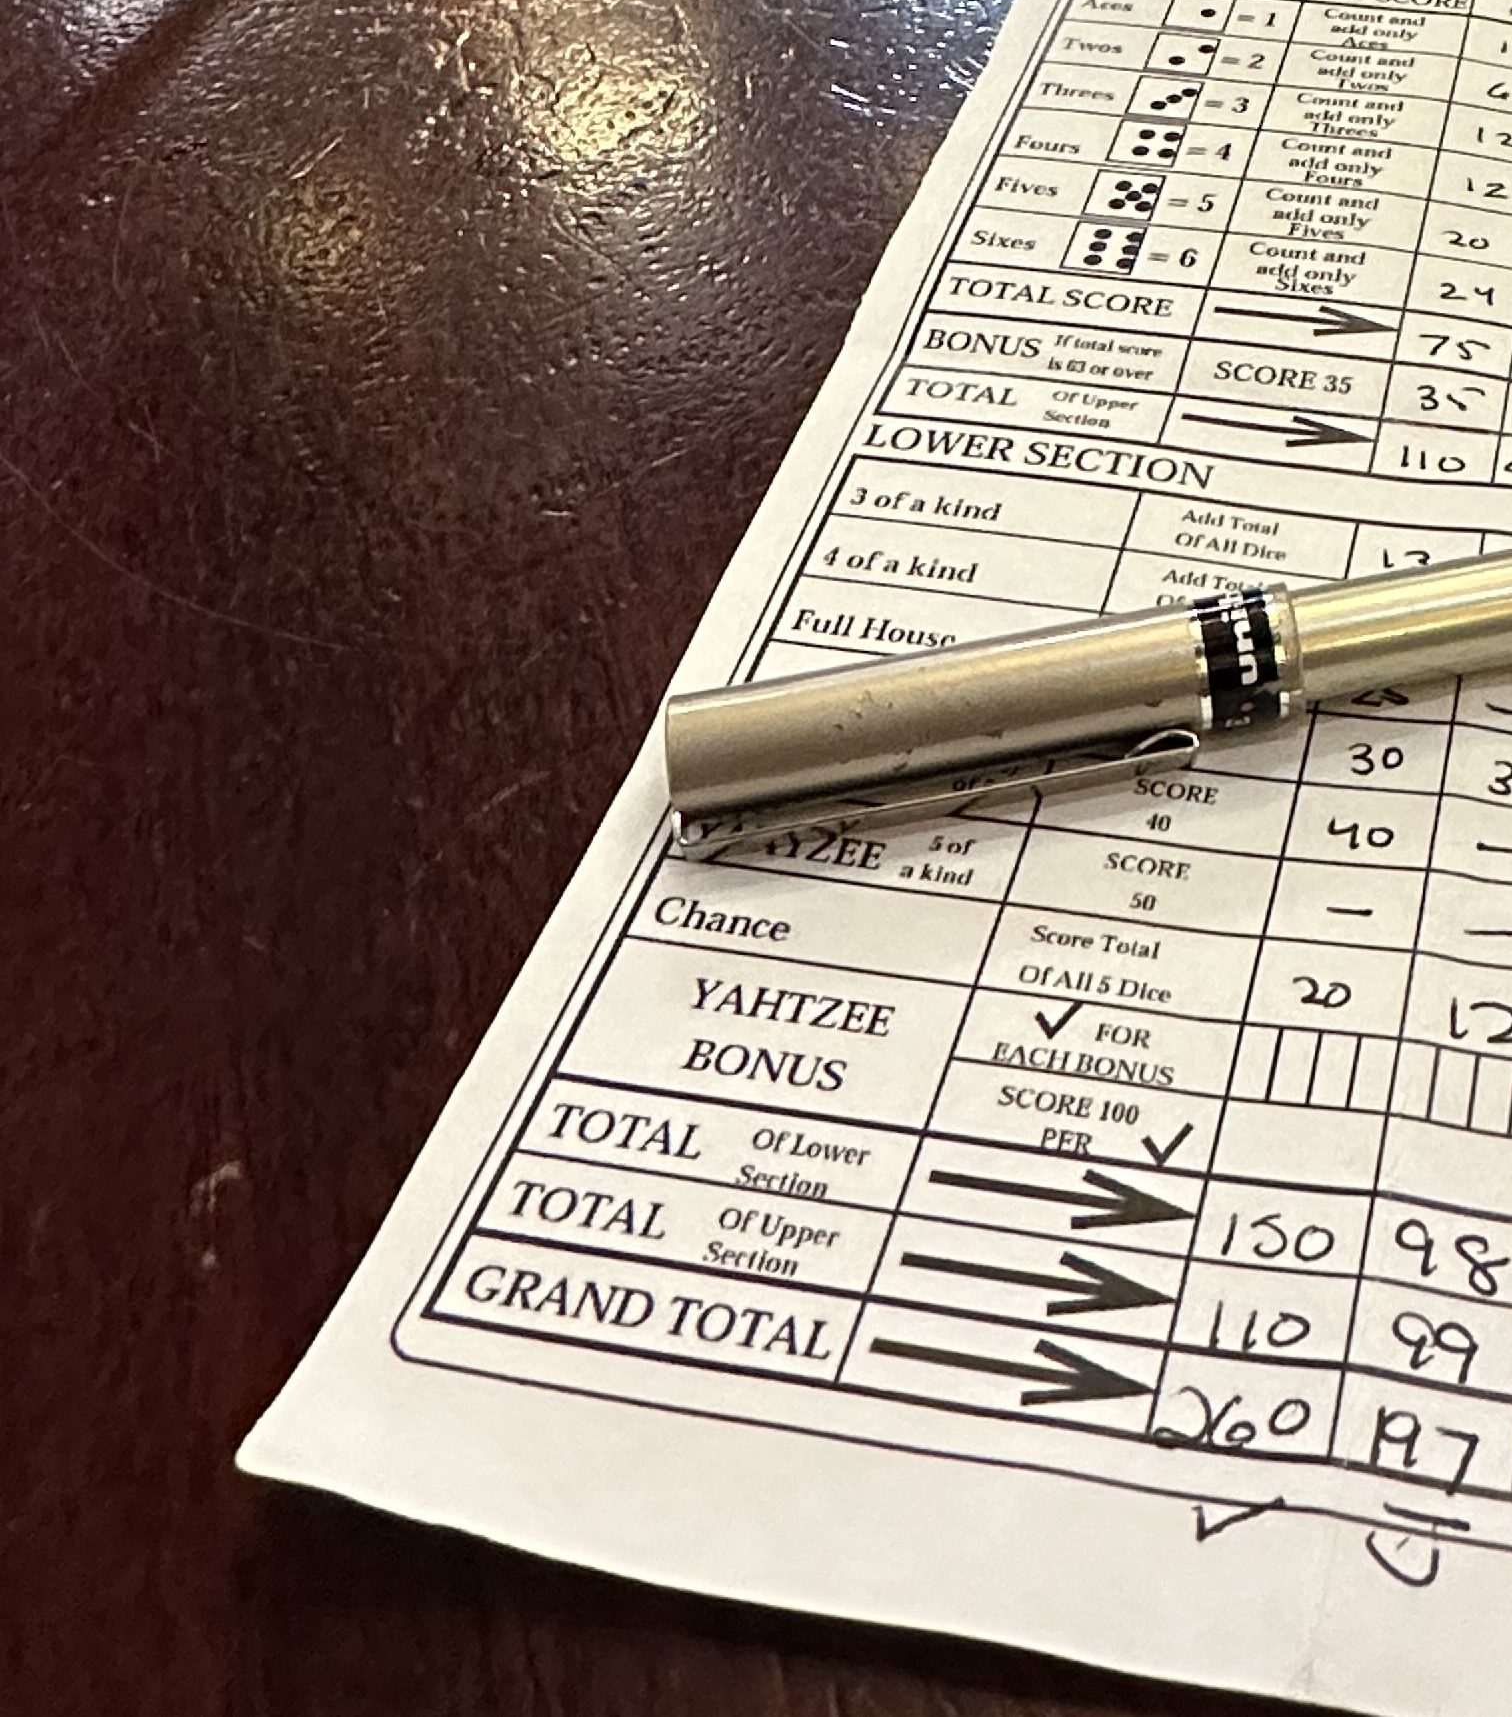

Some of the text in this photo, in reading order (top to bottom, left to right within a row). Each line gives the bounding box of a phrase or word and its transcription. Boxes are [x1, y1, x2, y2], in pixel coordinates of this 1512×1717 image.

[1062, 36, 1124, 56] Twos
[1039, 82, 1116, 104] Threes
[1012, 133, 1082, 157] Fours
[993, 176, 1060, 199] Fives
[1465, 176, 1510, 200] 12
[970, 228, 1038, 254] Sixes
[1446, 229, 1491, 252] 20
[946, 275, 1175, 319] TOTAL SCORE
[1440, 281, 1495, 306] 24
[922, 326, 1042, 360] BONUS
[1419, 332, 1492, 361] 75
[904, 376, 1019, 408] TOTAL
[1214, 359, 1353, 394] SCORE 35
[1051, 387, 1140, 414] Of Upper
[1417, 384, 1486, 413] 35
[1042, 408, 1112, 430] Section
[863, 422, 1216, 490] LOWER SECTION
[1400, 445, 1467, 474] 110
[849, 486, 1004, 523] 3 of a kind
[822, 546, 979, 585] 4 of a kind
[791, 607, 857, 640] Full
[1347, 742, 1405, 775] 30
[1133, 776, 1220, 807] SCORE
[1144, 812, 1172, 834] 40
[1326, 816, 1395, 850] 40
[1102, 850, 1193, 882] SCORE
[653, 895, 792, 943] Chance
[1127, 890, 1158, 914] 50
[1029, 923, 1162, 962] Score Total
[1018, 964, 1054, 988] Of
[1053, 967, 1096, 995] All
[1112, 976, 1172, 1005] Dice
[1291, 975, 1352, 1010] 20
[688, 975, 896, 1040] YAHTZEE
[1095, 1020, 1152, 1051] FOR
[681, 1038, 848, 1094] BONUS
[989, 1041, 1176, 1086] EACH BONUS
[996, 1083, 1140, 1128] SCORE 100
[547, 1103, 702, 1163] TOTAL
[750, 1125, 872, 1169] Of Lower
[1039, 1126, 1092, 1157] PER
[733, 1163, 830, 1202] Section
[509, 1179, 667, 1243] TOTAL
[718, 1205, 840, 1250] Of Upper
[701, 1239, 799, 1279] Section
[1393, 1217, 1510, 1298] 98
[463, 1262, 832, 1362] GRAND TOTAL
[1209, 1299, 1312, 1350] 110
[1390, 1311, 1479, 1385] 99
[1151, 1385, 1312, 1451] 260
[1370, 1404, 1480, 1496] 197
